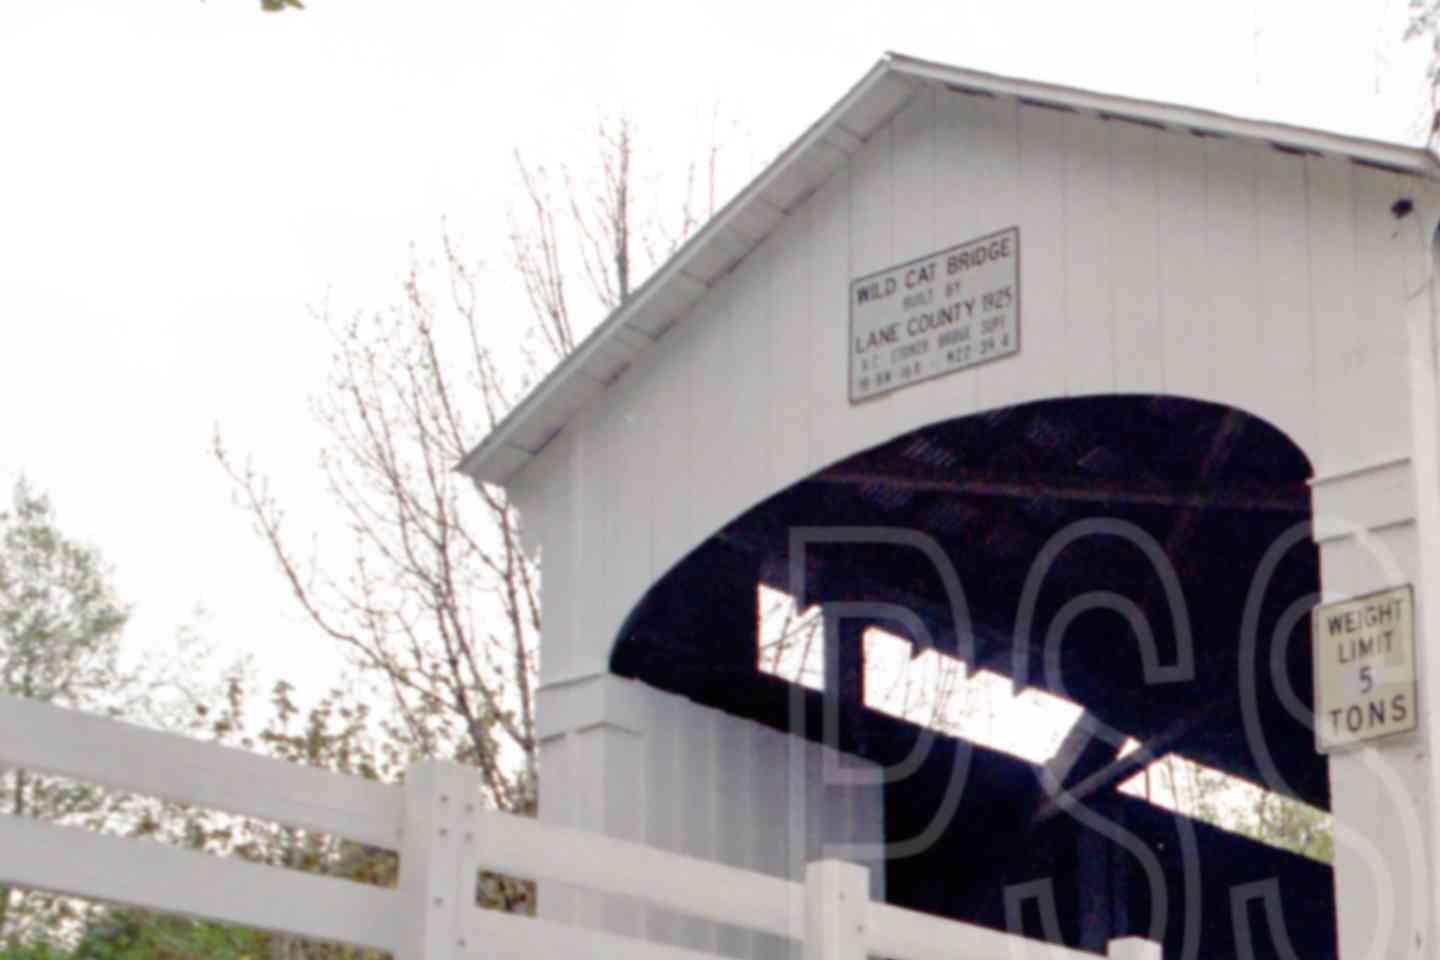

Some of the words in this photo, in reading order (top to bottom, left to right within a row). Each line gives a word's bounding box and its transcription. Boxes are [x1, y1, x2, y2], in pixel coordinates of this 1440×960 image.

[857, 277, 897, 305] WILD
[904, 262, 937, 289] CAT
[946, 237, 1011, 275] BRIDGE
[945, 281, 961, 298] BY
[855, 322, 899, 354] LANE
[906, 298, 976, 337] COUNTY
[982, 287, 1013, 312] 1925
[1328, 599, 1403, 636] WEIGHT
[1338, 630, 1393, 665] LIMIT
[1360, 666, 1373, 694] 5
[1329, 694, 1408, 733] TONS
